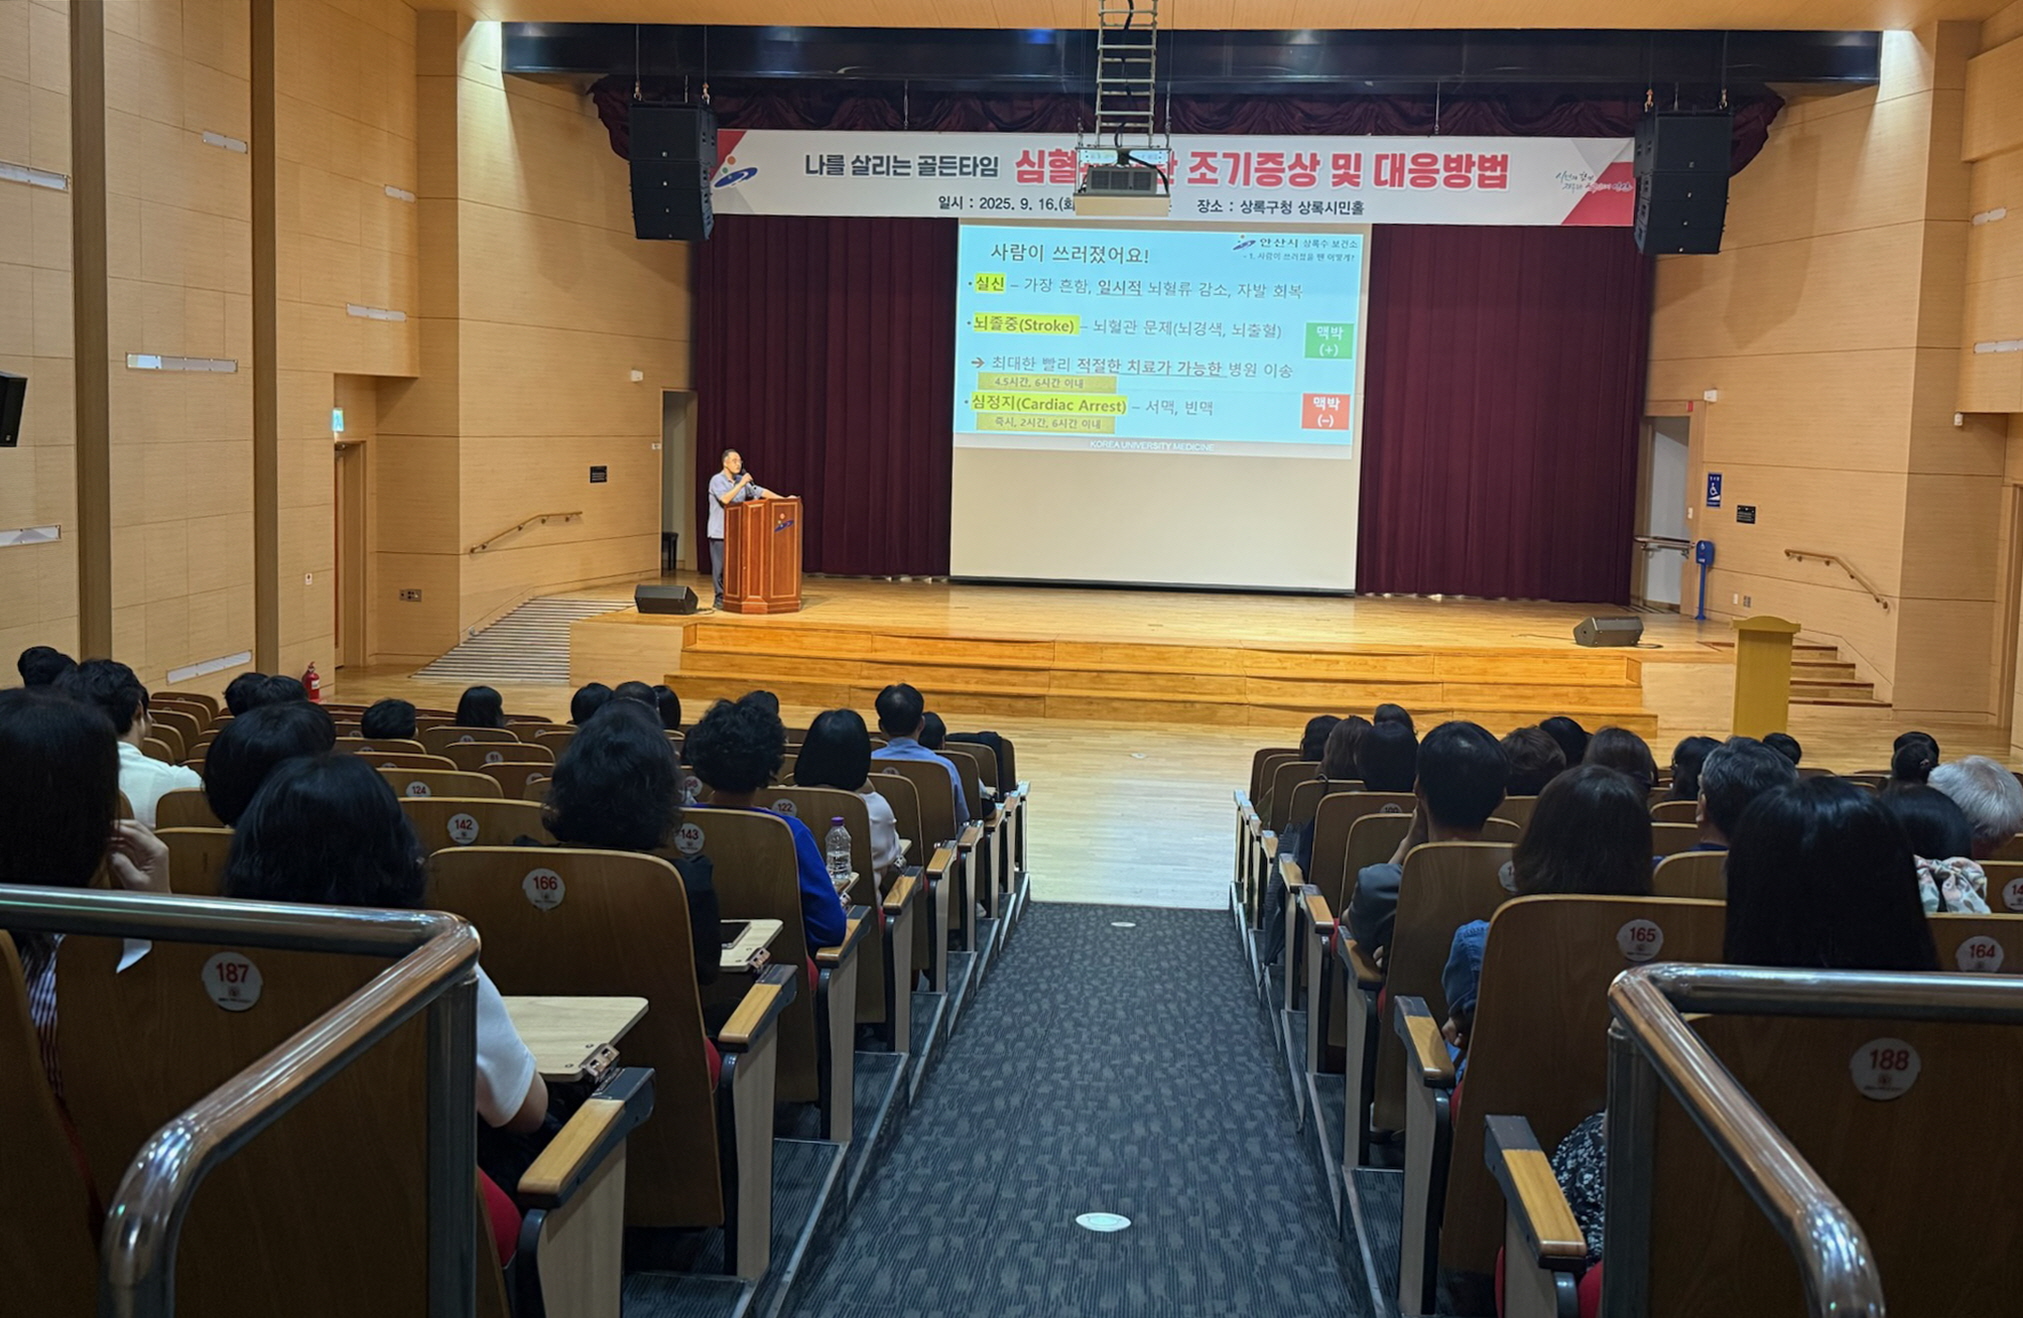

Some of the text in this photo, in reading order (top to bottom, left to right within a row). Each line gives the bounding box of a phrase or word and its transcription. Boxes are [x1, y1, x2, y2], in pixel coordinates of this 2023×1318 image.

[804, 153, 846, 177] 나를
[850, 154, 912, 177] 살리는
[917, 155, 1000, 178] 골든타임
[1187, 151, 1320, 187] 조기증상
[1331, 153, 1363, 189] 및
[1373, 153, 1510, 190] 대응방법
[938, 195, 964, 210] 일시
[979, 196, 1015, 212] 2025.
[1020, 197, 1034, 212] 9.
[1197, 199, 1224, 214] 장소
[1240, 200, 1293, 215] 상록구청
[1297, 200, 1365, 216] 상록시민홀
[1260, 238, 1299, 248] 안산시
[991, 243, 1149, 265] 사람이 쓰러졌어요!
[975, 276, 1005, 292] 실신
[1024, 278, 1053, 294] 가장
[1059, 279, 1092, 295] 흔함,
[1097, 279, 1142, 295] 일시적
[1148, 281, 1192, 298] 뇌혈류
[1199, 282, 1231, 298] 감소,
[1237, 283, 1267, 299] 자발
[1273, 284, 1303, 299] 회복
[974, 315, 1075, 335] 뇌졸중(Stroke)
[1093, 319, 1138, 335] 뇌혈관
[1143, 320, 1226, 338] 문제(뇌경색,
[1232, 322, 1282, 340] 뇌출혈)
[1316, 325, 1344, 341] 맥박
[1319, 344, 1339, 358] (+)
[992, 356, 1294, 379] 최대한 빨리 적절한 치료가 가능한 병원 이송
[994, 376, 1085, 390] 4.5시간, 6시간 이내
[972, 395, 1074, 412] 심정지(Cardiac
[1078, 399, 1127, 415] Arrest)
[1145, 400, 1178, 416] 서맥,
[1185, 401, 1214, 417] 빈맥
[1312, 396, 1341, 412] 맥박
[1020, 417, 1049, 429] 2시간,
[1051, 418, 1078, 430] 6시간
[1089, 439, 1215, 452] KOREA UNIVERSITY MEDICINE
[411, 785, 427, 795] 124
[777, 802, 793, 813] 122
[454, 819, 473, 831] 142
[680, 828, 699, 841] 143
[532, 875, 558, 890] 166
[2011, 884, 2023, 896] 14
[1629, 927, 1656, 942] 165
[1969, 943, 1996, 958] 164
[215, 961, 249, 983] 187
[1868, 1048, 1909, 1072] 188
